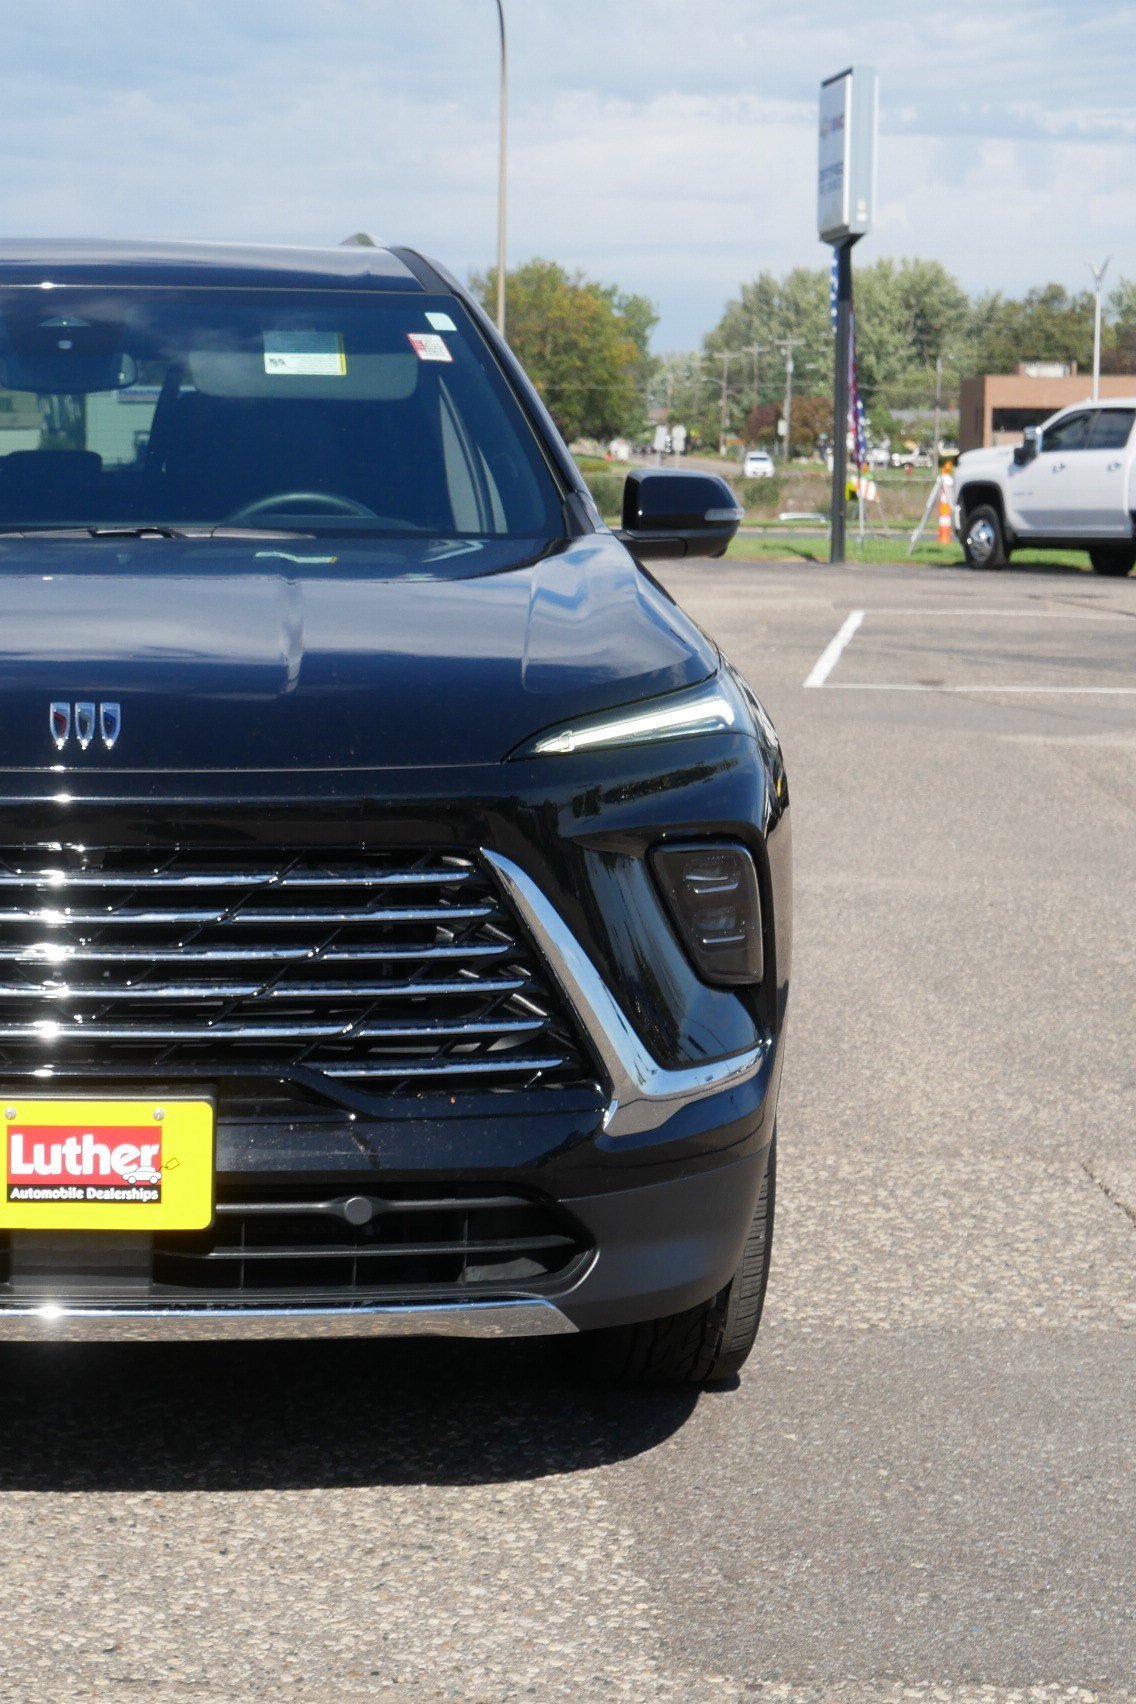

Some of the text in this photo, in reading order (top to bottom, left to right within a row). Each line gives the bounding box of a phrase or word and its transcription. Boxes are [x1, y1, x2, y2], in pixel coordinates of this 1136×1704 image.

[11, 1134, 160, 1175] Luther
[10, 1187, 159, 1202] Automobile Dealerships
